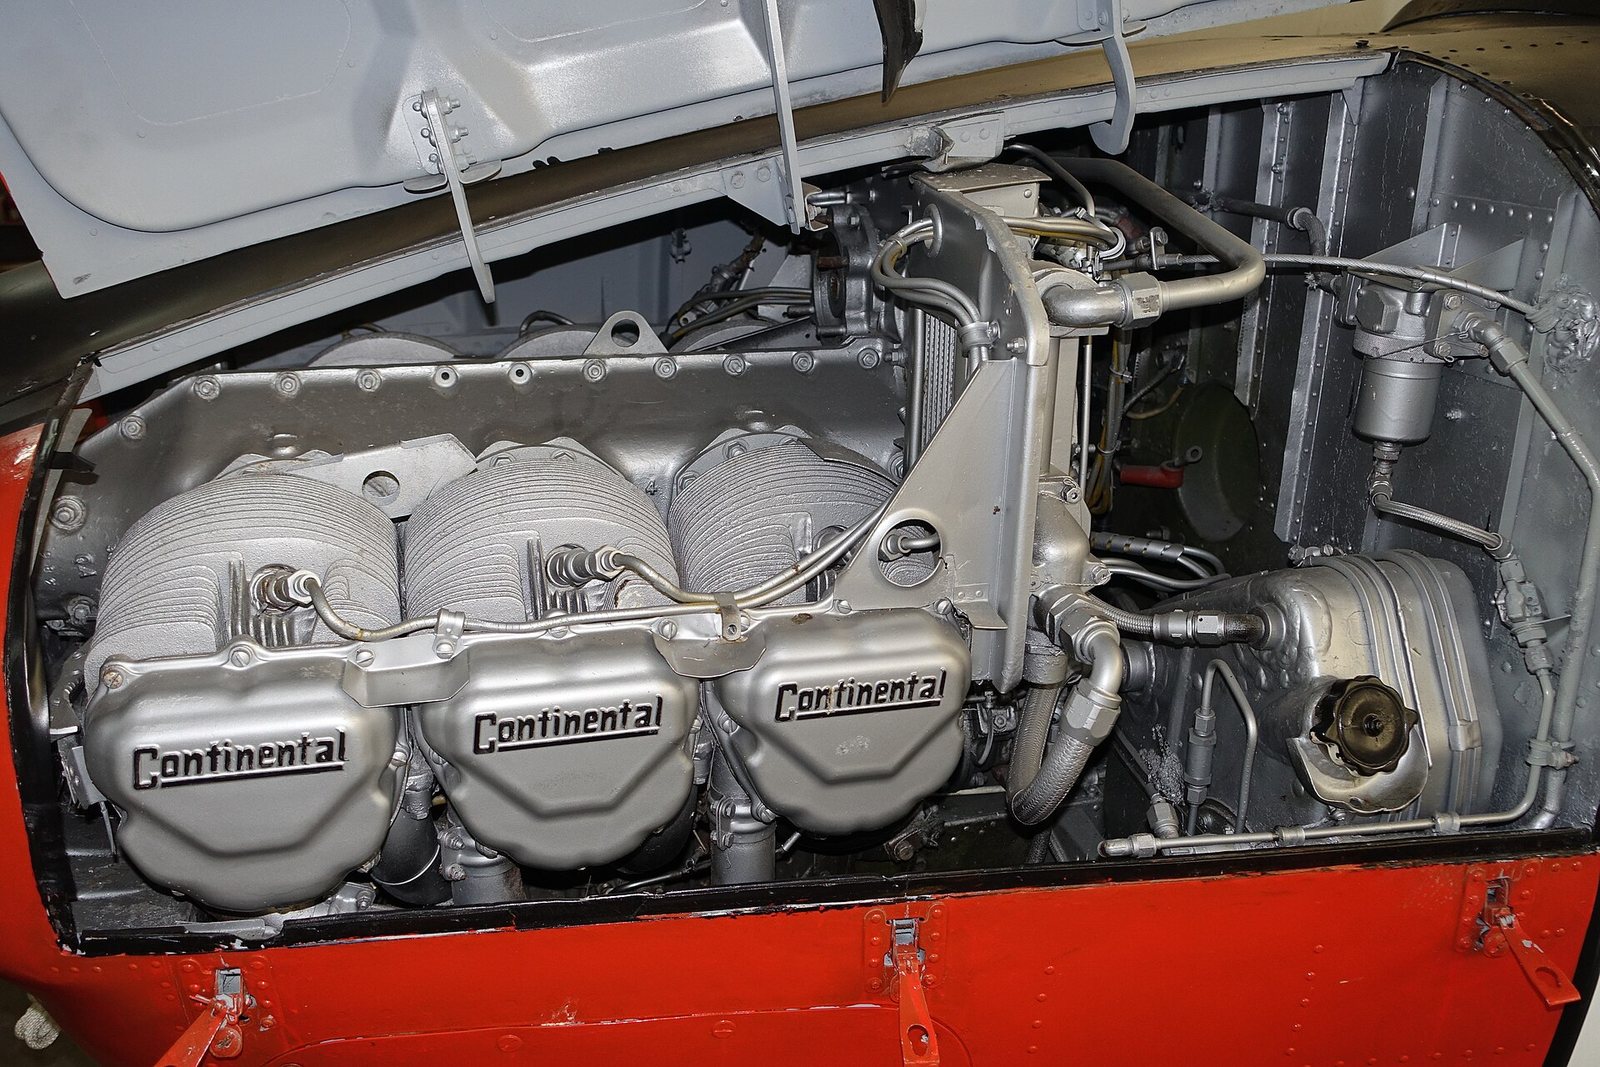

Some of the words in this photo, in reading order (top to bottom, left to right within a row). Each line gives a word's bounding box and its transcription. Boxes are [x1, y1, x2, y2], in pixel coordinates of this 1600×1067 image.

[473, 694, 664, 755] Continental
[775, 667, 947, 722] Continental
[133, 726, 348, 790] Continental
